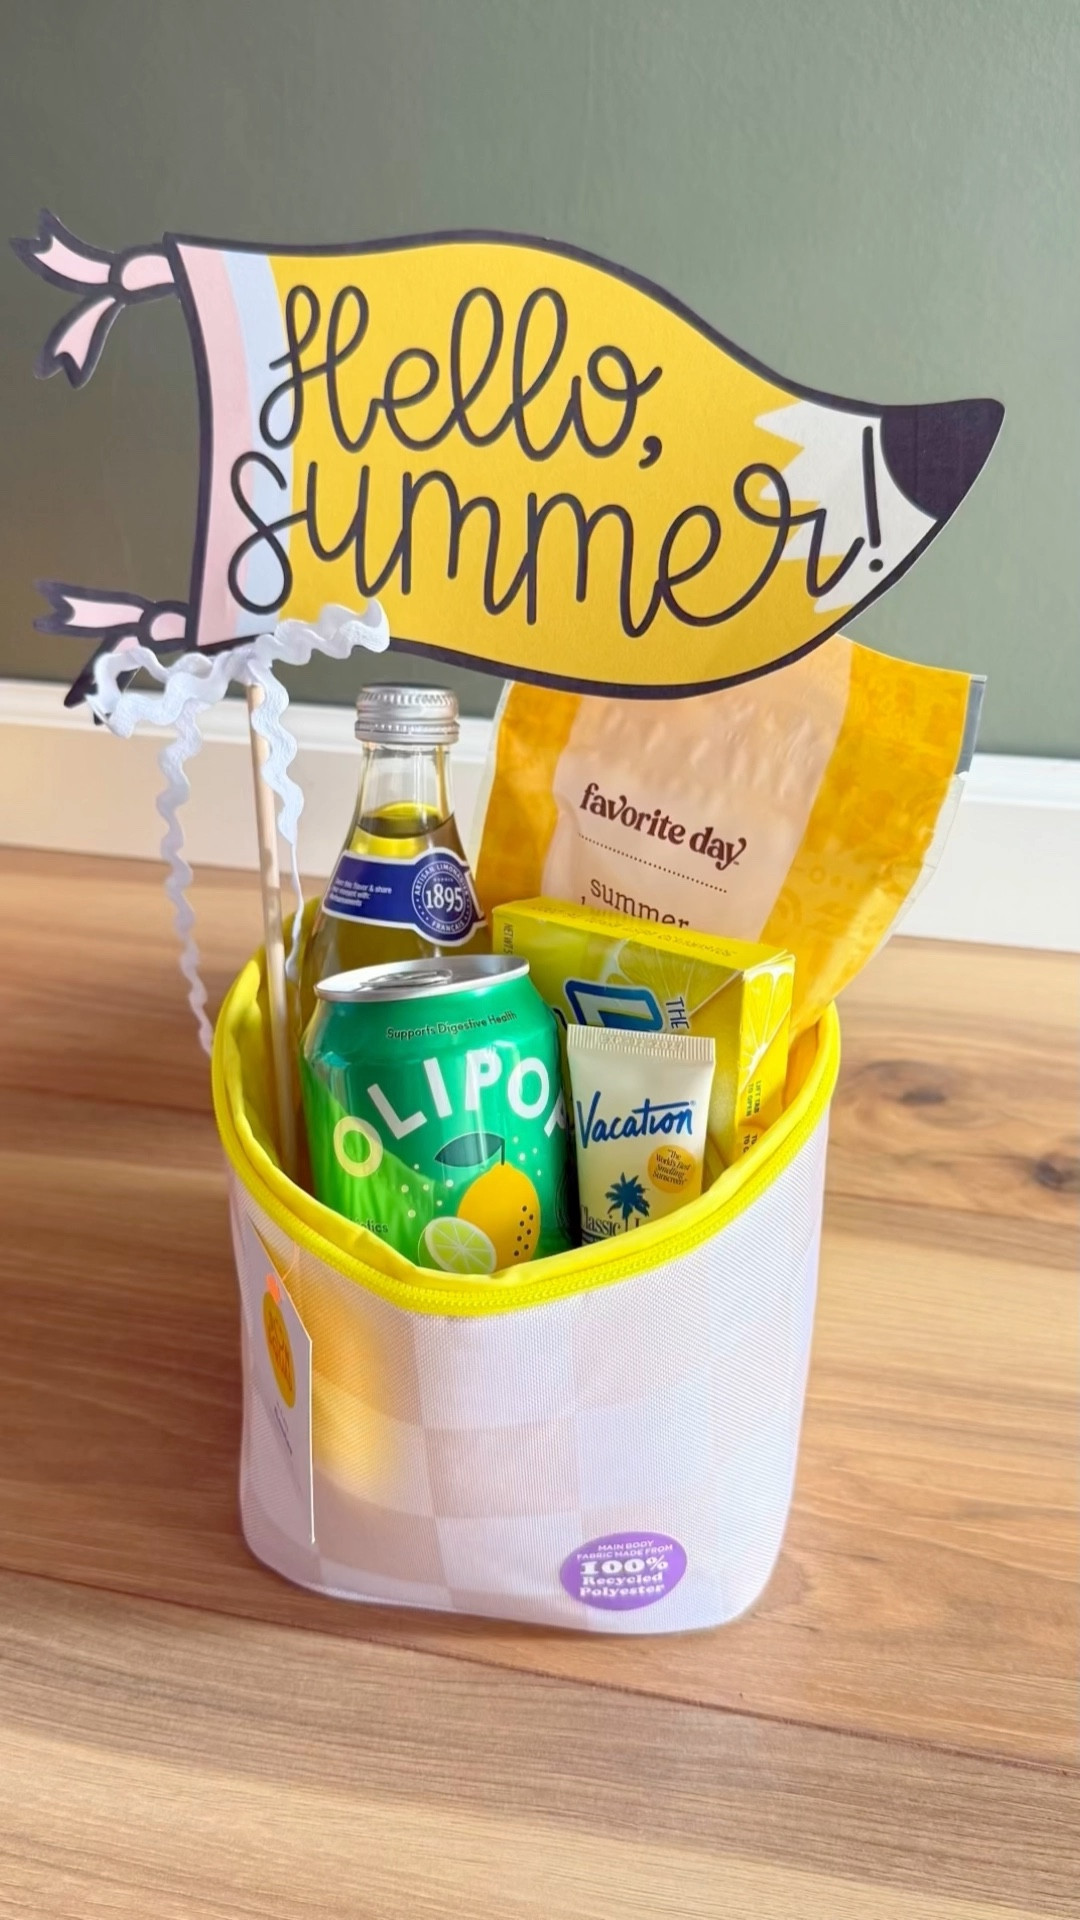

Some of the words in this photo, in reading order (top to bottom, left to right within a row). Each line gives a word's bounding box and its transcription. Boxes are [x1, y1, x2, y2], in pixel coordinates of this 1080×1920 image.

[259, 286, 663, 468] Hello,
[579, 782, 686, 845] favorite
[689, 827, 747, 871] day
[414, 865, 435, 896] ARTISAN
[425, 883, 464, 913] 1895
[590, 879, 690, 928] summer
[386, 1024, 436, 1041] Supports
[437, 1018, 488, 1035] Digestive
[488, 1009, 518, 1025] Health
[665, 996, 690, 1030] THE
[576, 1090, 693, 1149] Vacation
[580, 1205, 621, 1237] lassic
[577, 1551, 613, 1560] FABRIC
[614, 1549, 644, 1558] MADE
[645, 1544, 673, 1554] FROM
[598, 1543, 624, 1551] MAIN
[625, 1540, 655, 1549] BODY
[580, 1555, 669, 1575] 100%
[583, 1572, 663, 1586] Recycled
[580, 1584, 665, 1598] Polyester
